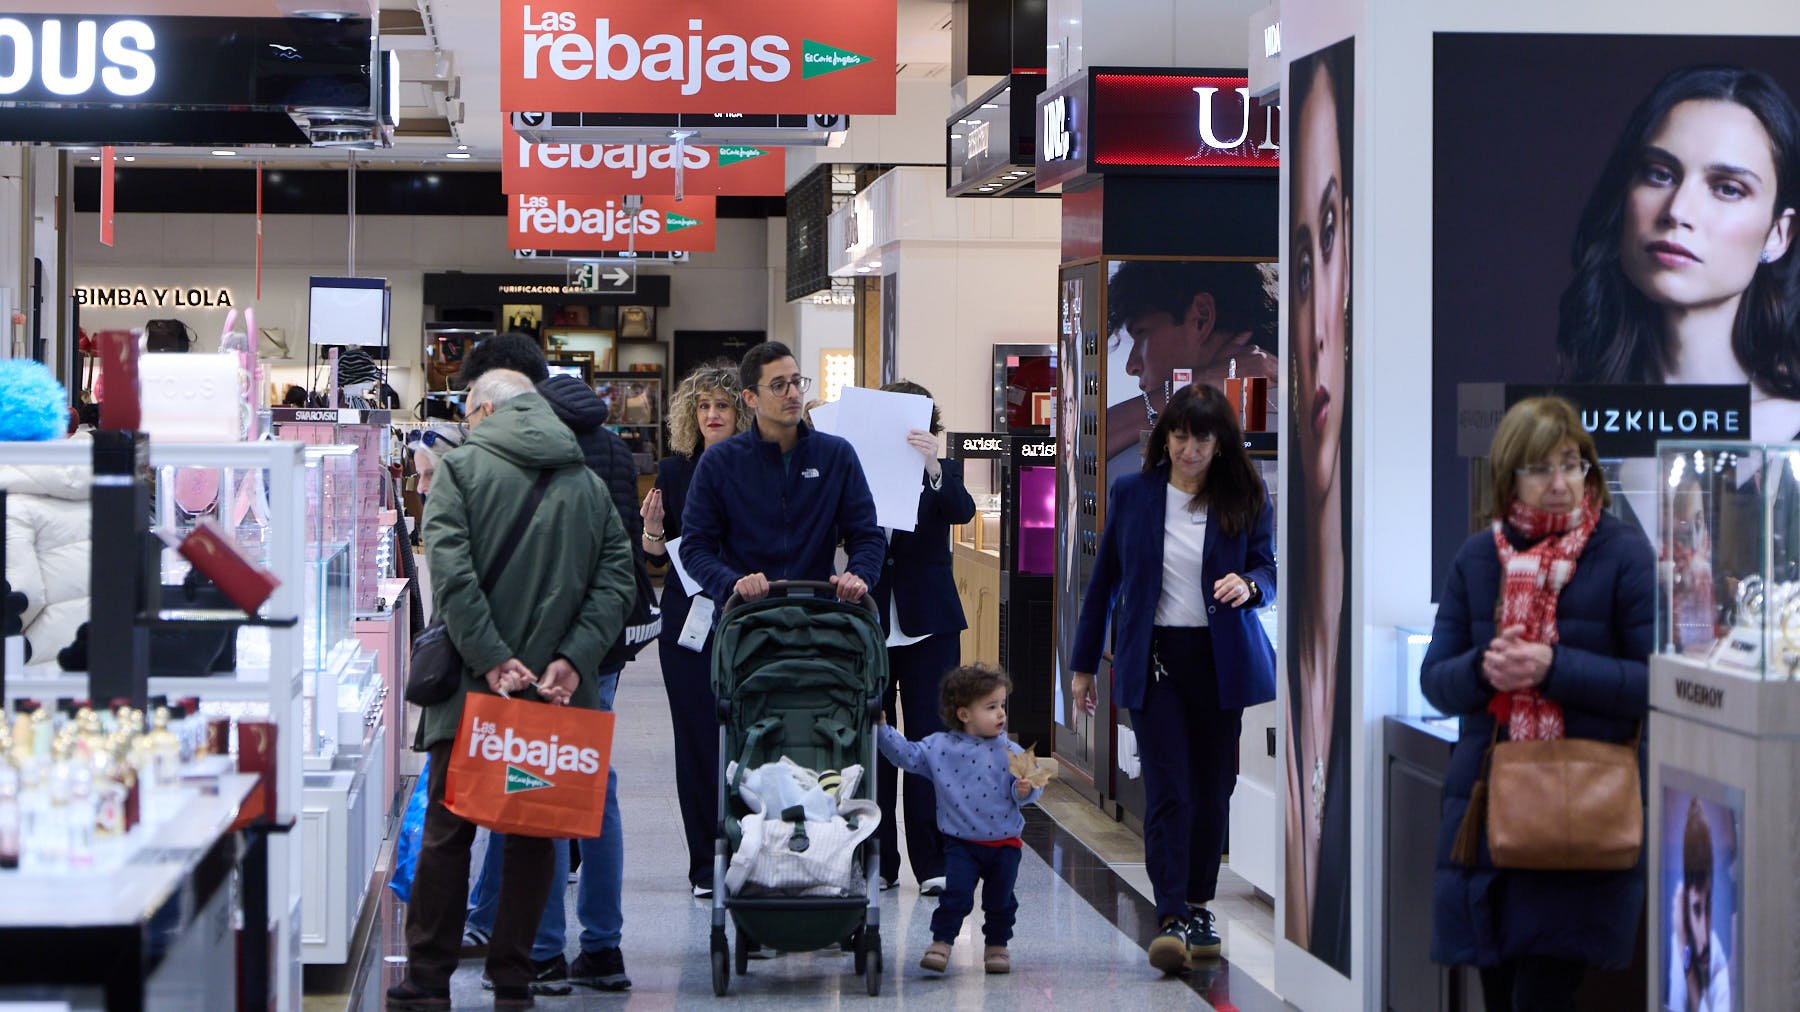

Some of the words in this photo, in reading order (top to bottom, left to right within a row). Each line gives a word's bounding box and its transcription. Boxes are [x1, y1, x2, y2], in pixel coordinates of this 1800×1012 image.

[523, 5, 576, 31] Las
[523, 18, 790, 95] rebajas
[519, 137, 710, 179] rebajas
[519, 194, 548, 208] Las
[519, 200, 661, 242] rebajas
[74, 288, 148, 307] BIMBA
[152, 288, 168, 307] Y
[174, 288, 232, 307] LOLA
[295, 410, 337, 421] SWAROVSKI
[1581, 408, 1740, 432] UZKILORE
[1675, 677, 1724, 709] VICEROY
[472, 716, 496, 735] Las
[468, 728, 600, 775] rebajas
